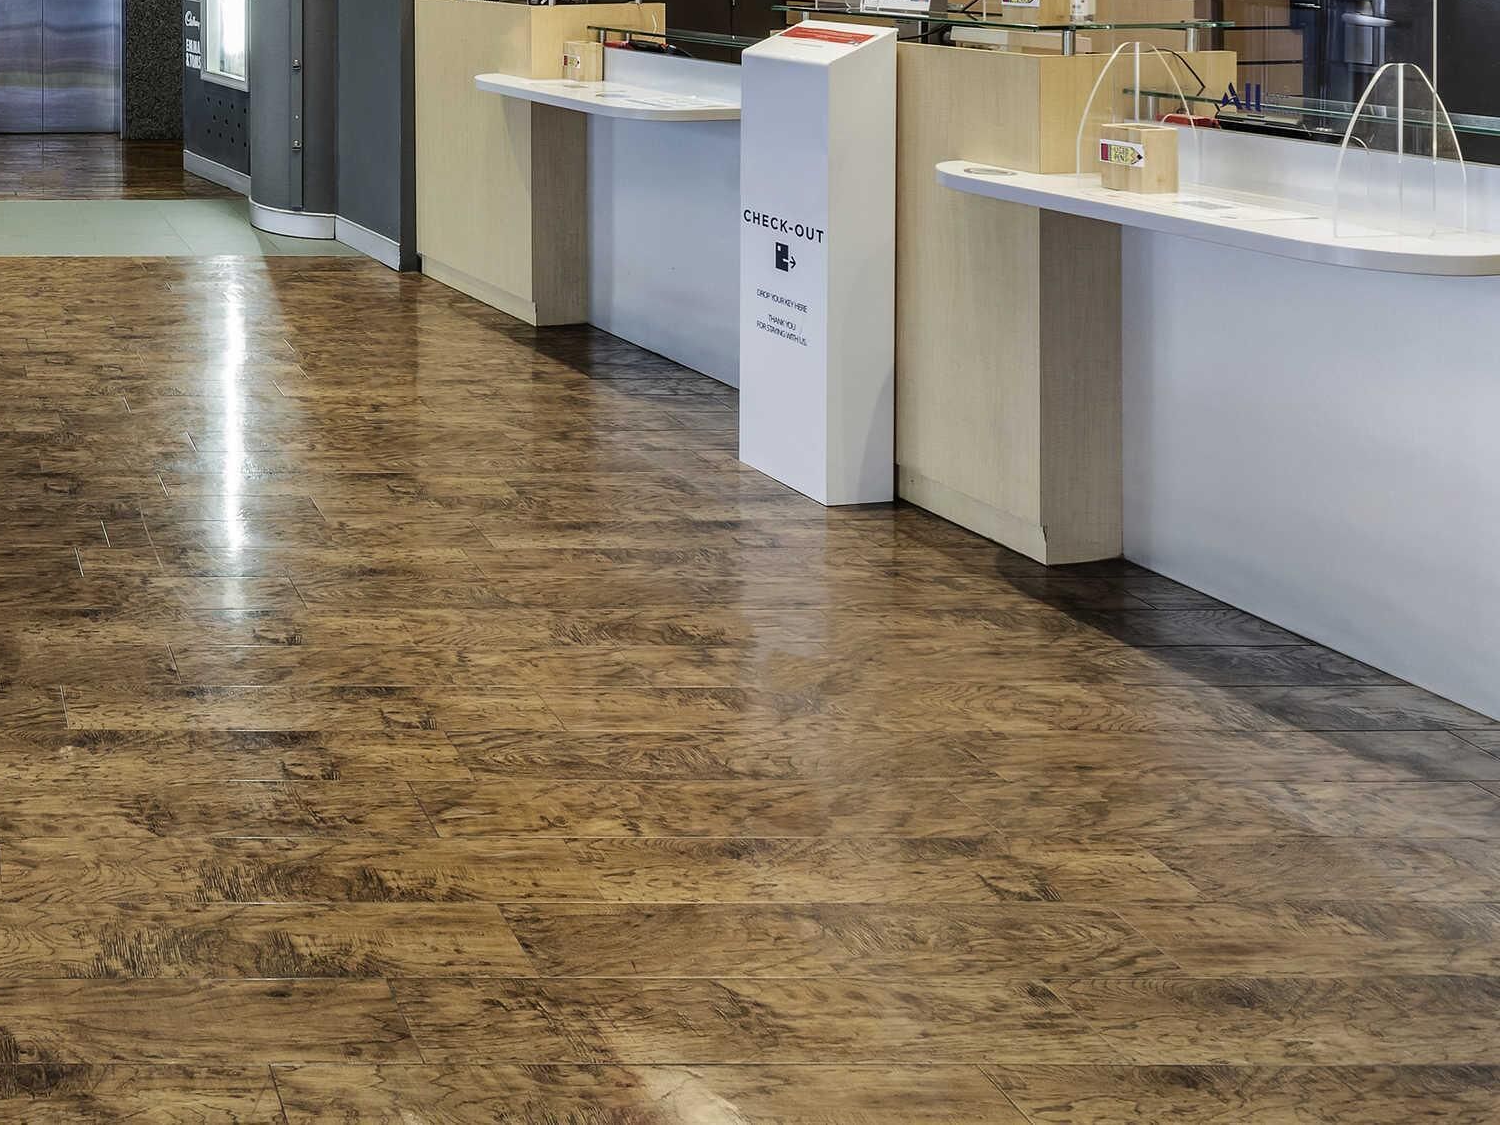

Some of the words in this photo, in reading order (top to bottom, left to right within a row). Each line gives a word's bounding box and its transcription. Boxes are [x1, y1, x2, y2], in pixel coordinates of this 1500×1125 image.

[743, 209, 824, 243] CHECK-OUT
[756, 320, 766, 330] FOR
[767, 314, 785, 326] THANK
[784, 320, 797, 331] YOU
